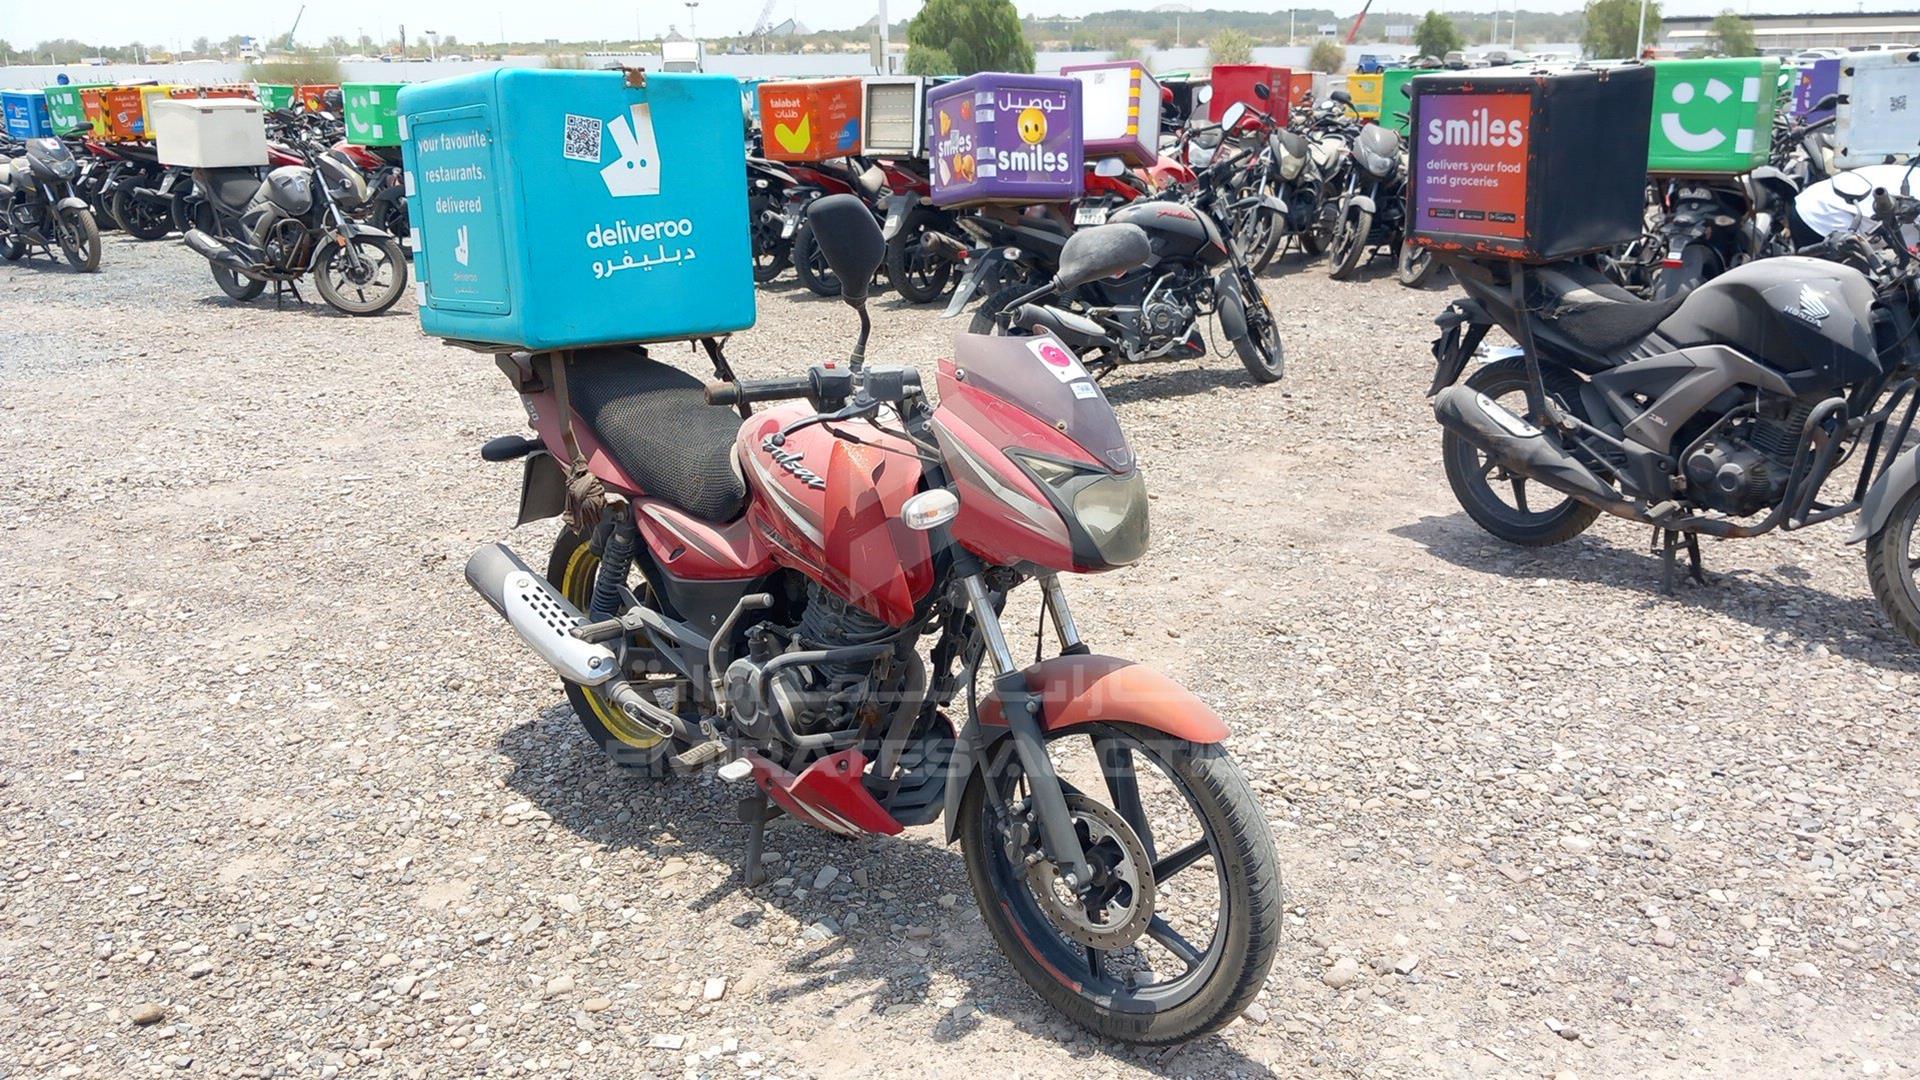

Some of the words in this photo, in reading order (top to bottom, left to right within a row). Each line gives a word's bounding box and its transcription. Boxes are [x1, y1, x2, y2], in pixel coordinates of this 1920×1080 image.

[770, 98, 801, 109] talabat
[998, 92, 1066, 114] توصيل
[1427, 107, 1523, 148] smiles
[417, 138, 438, 156] your
[440, 129, 487, 151] favourite
[997, 143, 1069, 172] smiles
[1426, 159, 1469, 171] delivers
[1470, 162, 1496, 174] your
[1496, 161, 1521, 174] food
[425, 163, 486, 183] restaurants.
[1426, 174, 1447, 185] and
[1448, 175, 1499, 188] groceries
[435, 195, 482, 214] delivered
[586, 218, 693, 249] deliveroo
